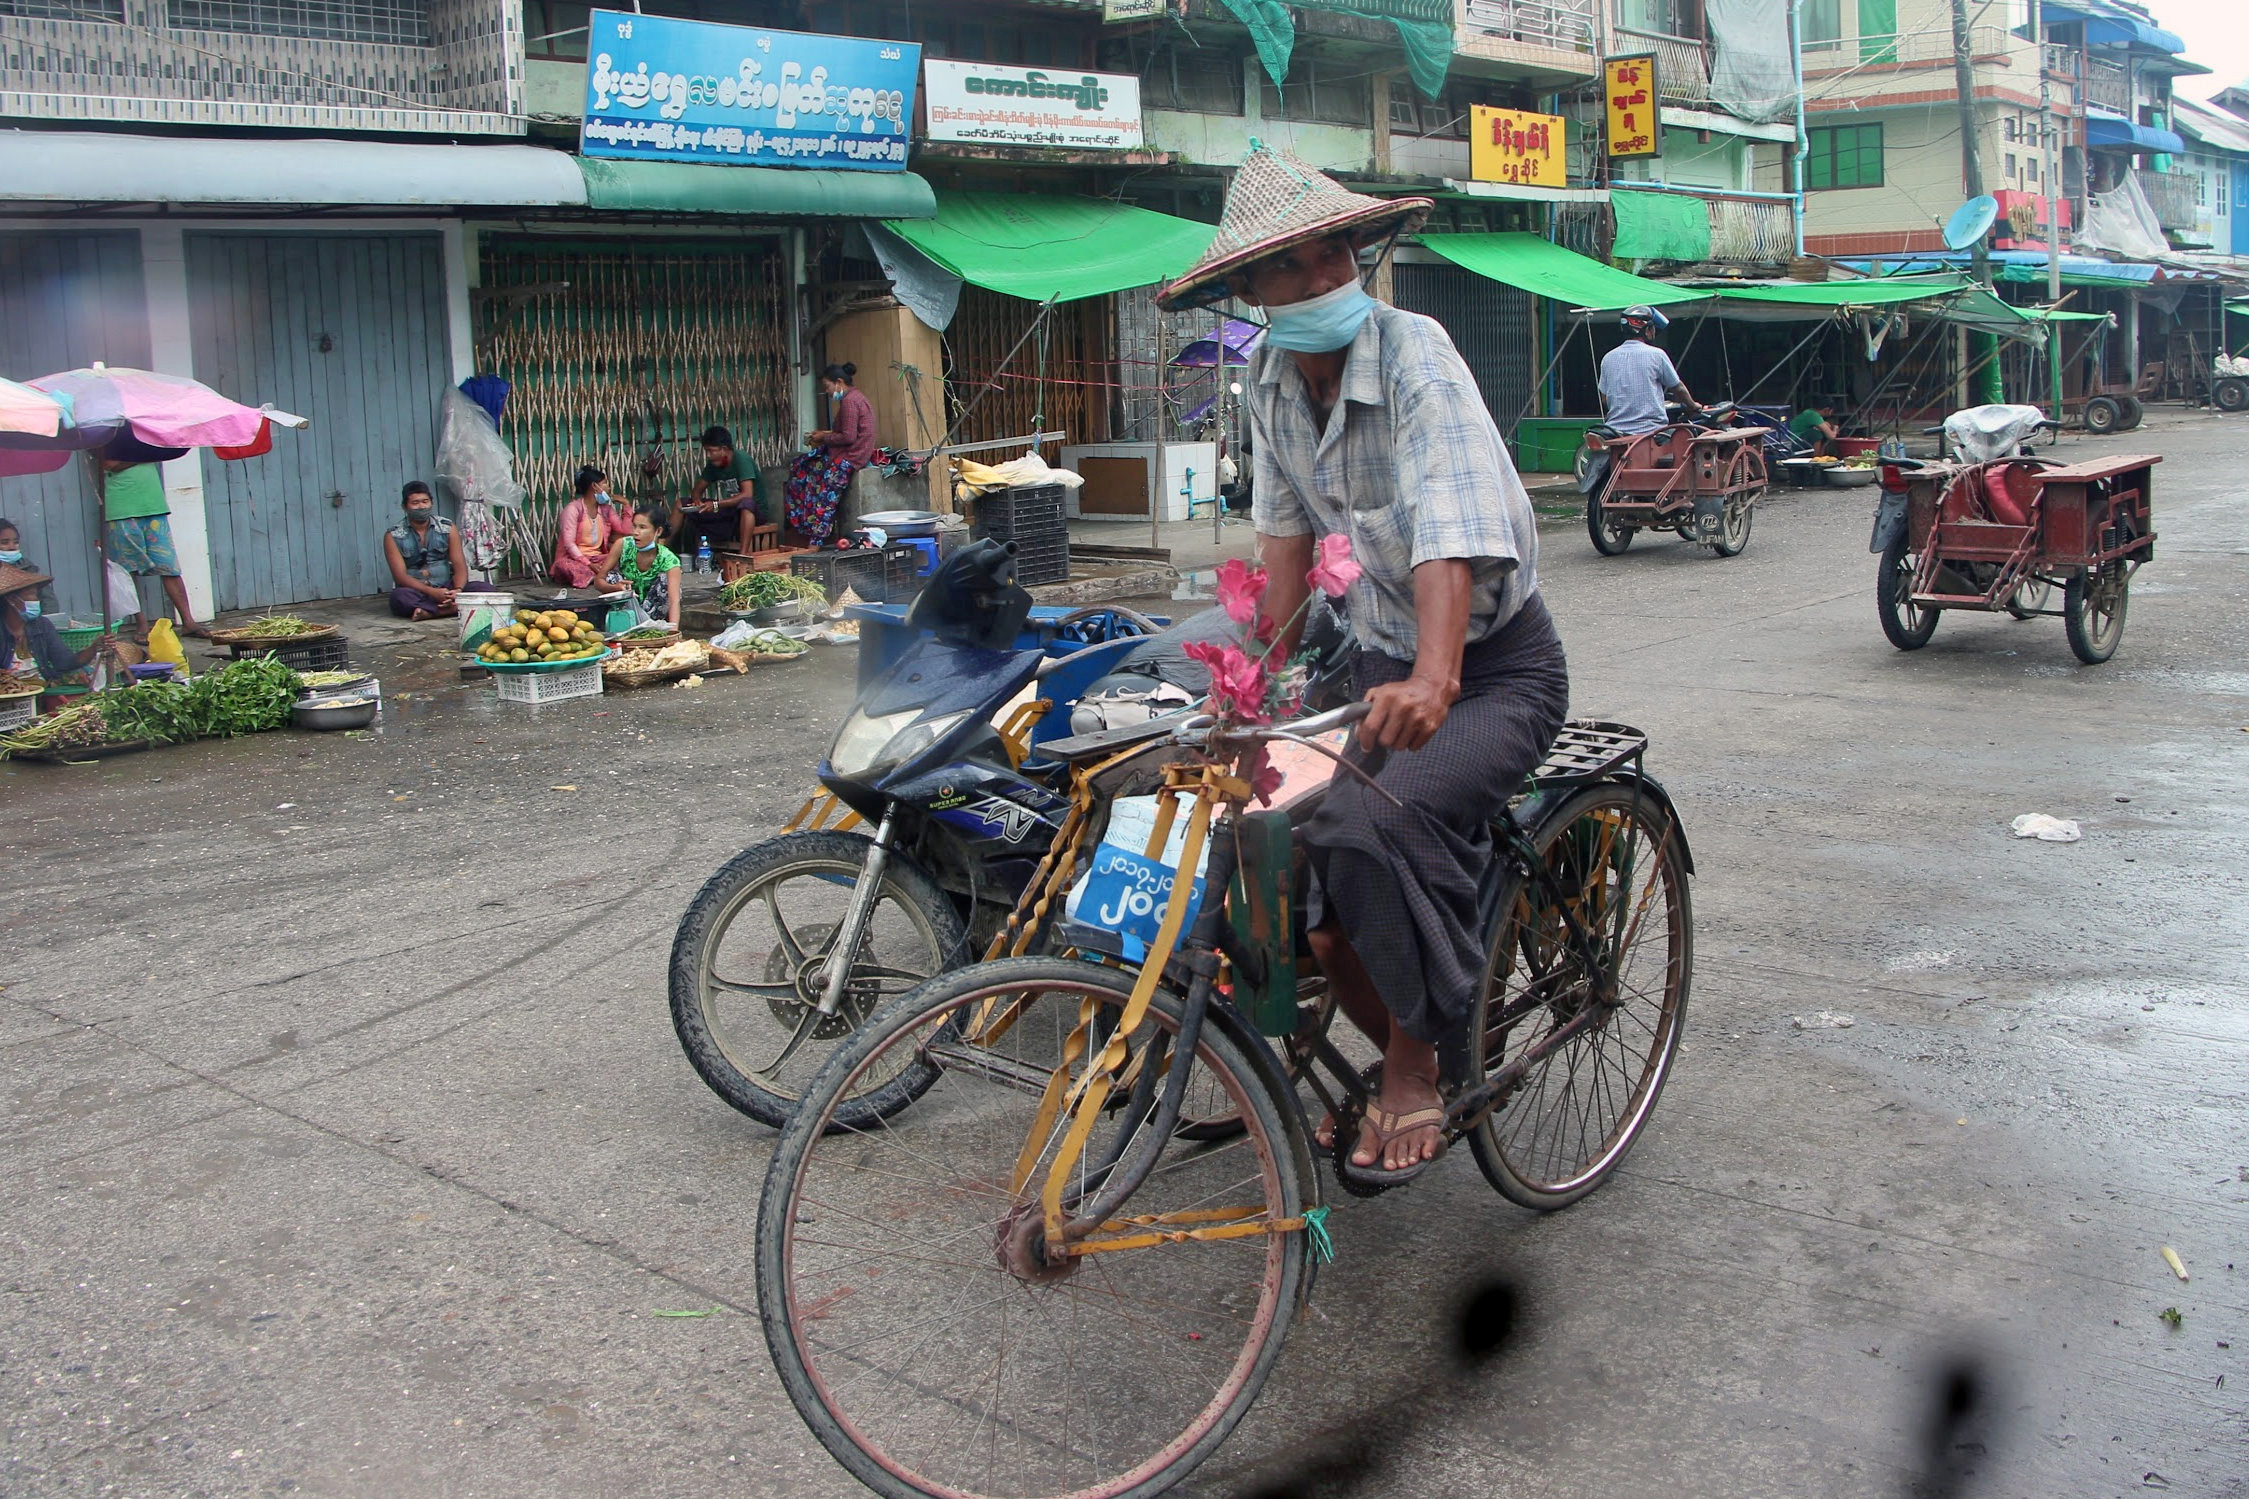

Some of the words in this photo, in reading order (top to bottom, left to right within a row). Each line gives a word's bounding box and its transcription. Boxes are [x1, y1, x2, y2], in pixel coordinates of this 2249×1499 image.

[964, 71, 1109, 111] ကောင်းကျိုး
